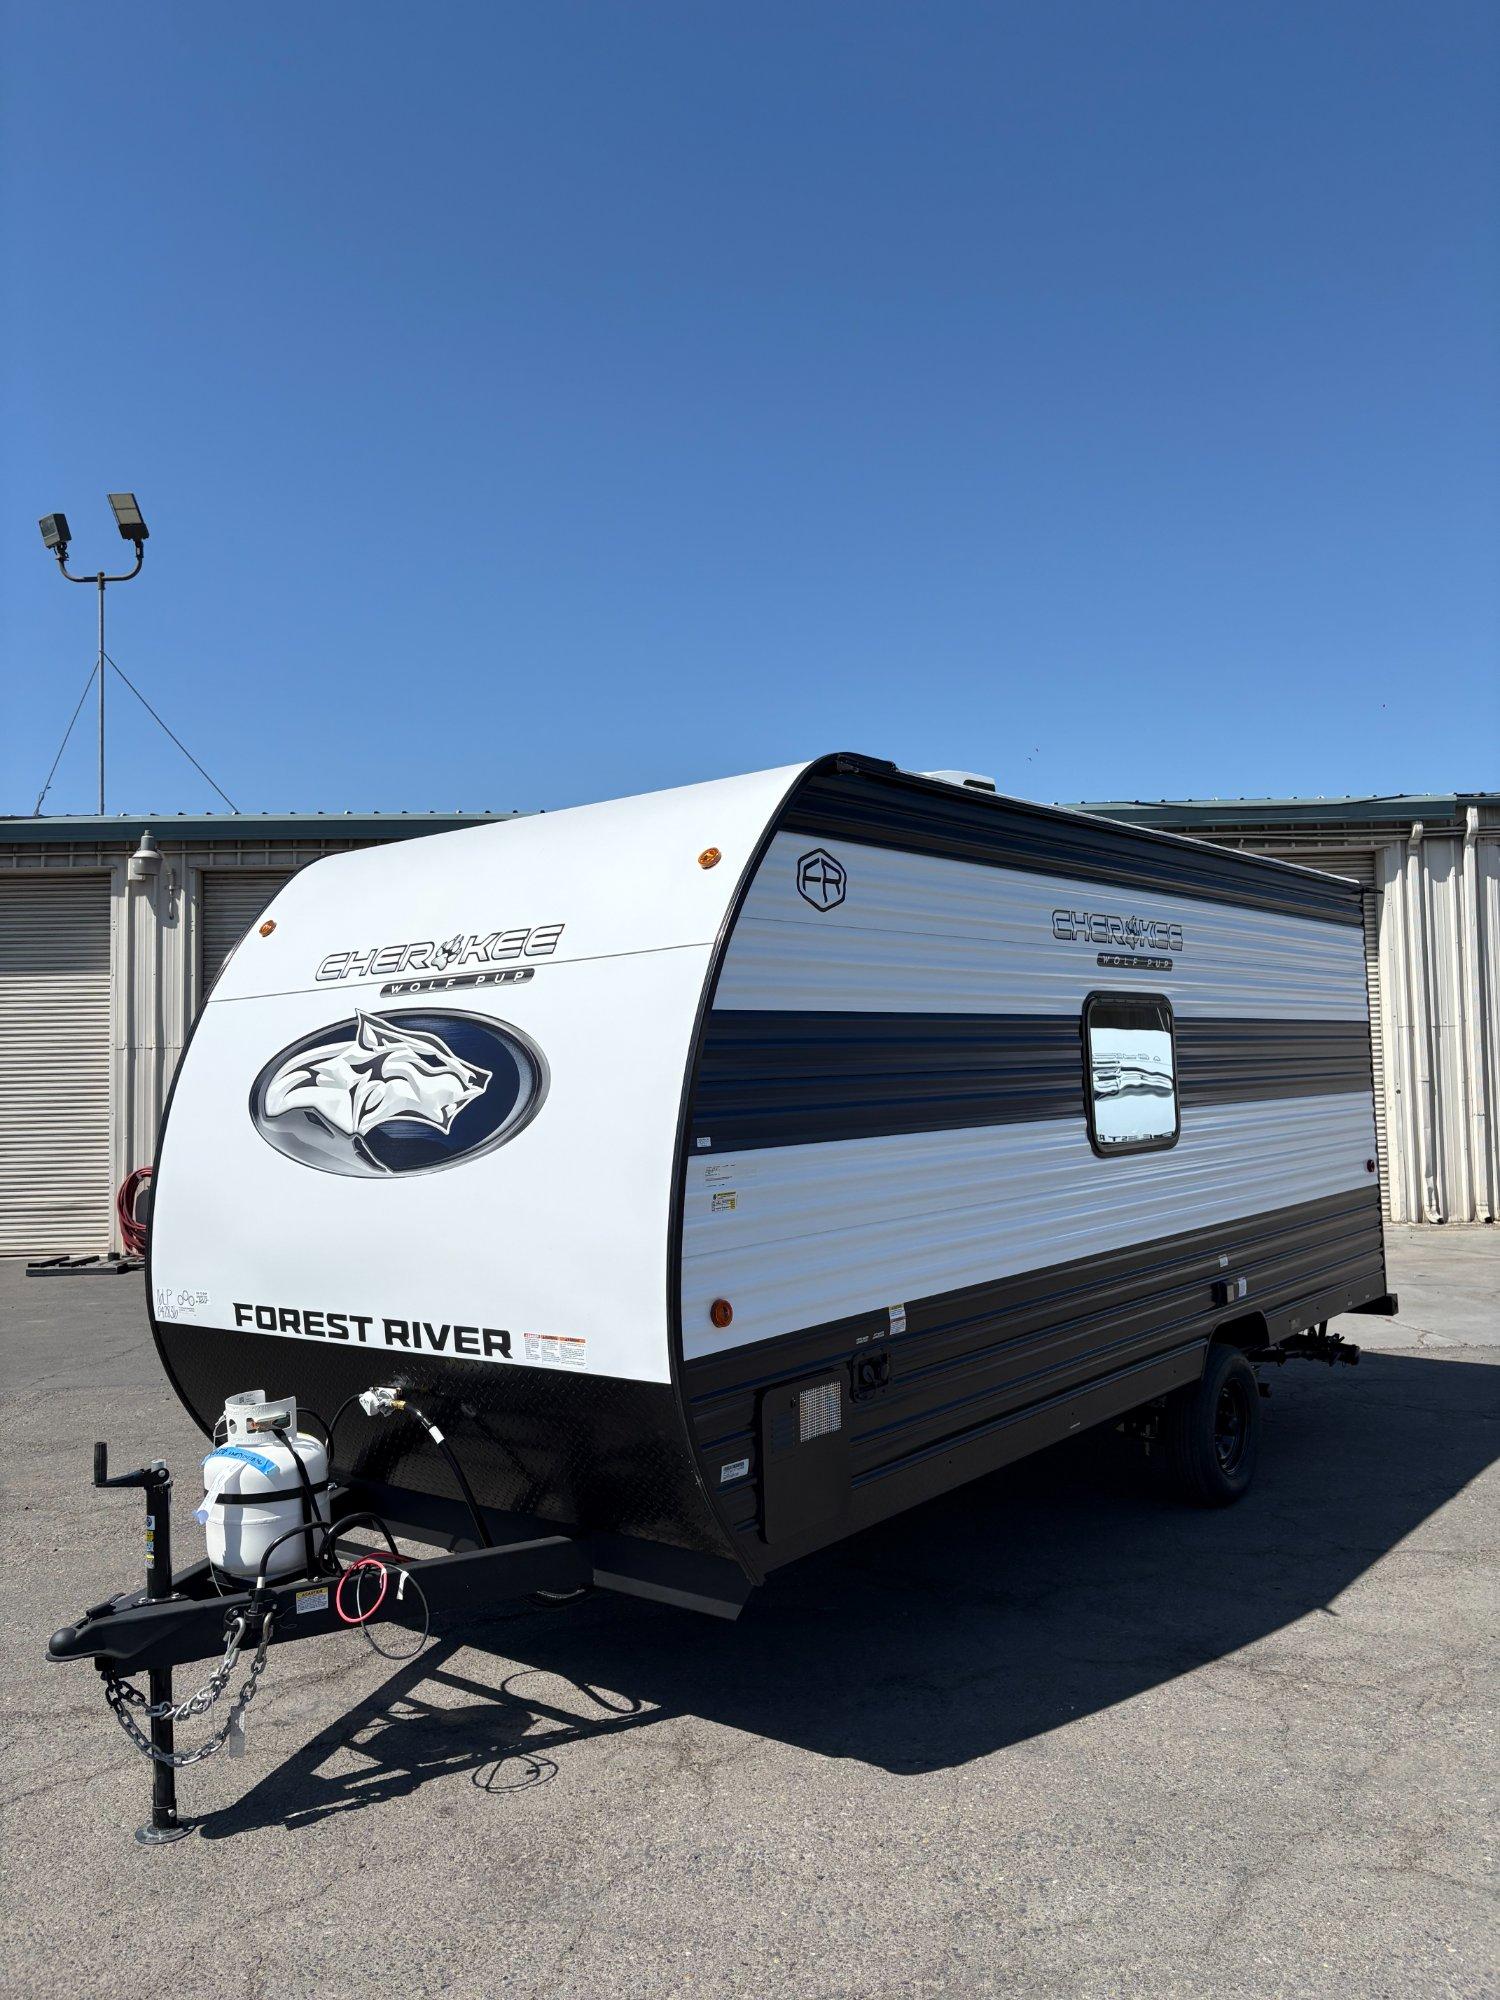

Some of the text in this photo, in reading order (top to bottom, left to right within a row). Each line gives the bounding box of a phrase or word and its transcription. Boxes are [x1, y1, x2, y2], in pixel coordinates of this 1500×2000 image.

[1102, 954, 1170, 969] WOLF PUP
[390, 970, 526, 995] WOLF PUP
[232, 1302, 374, 1342] FOREST
[381, 1318, 514, 1359] RIVER
